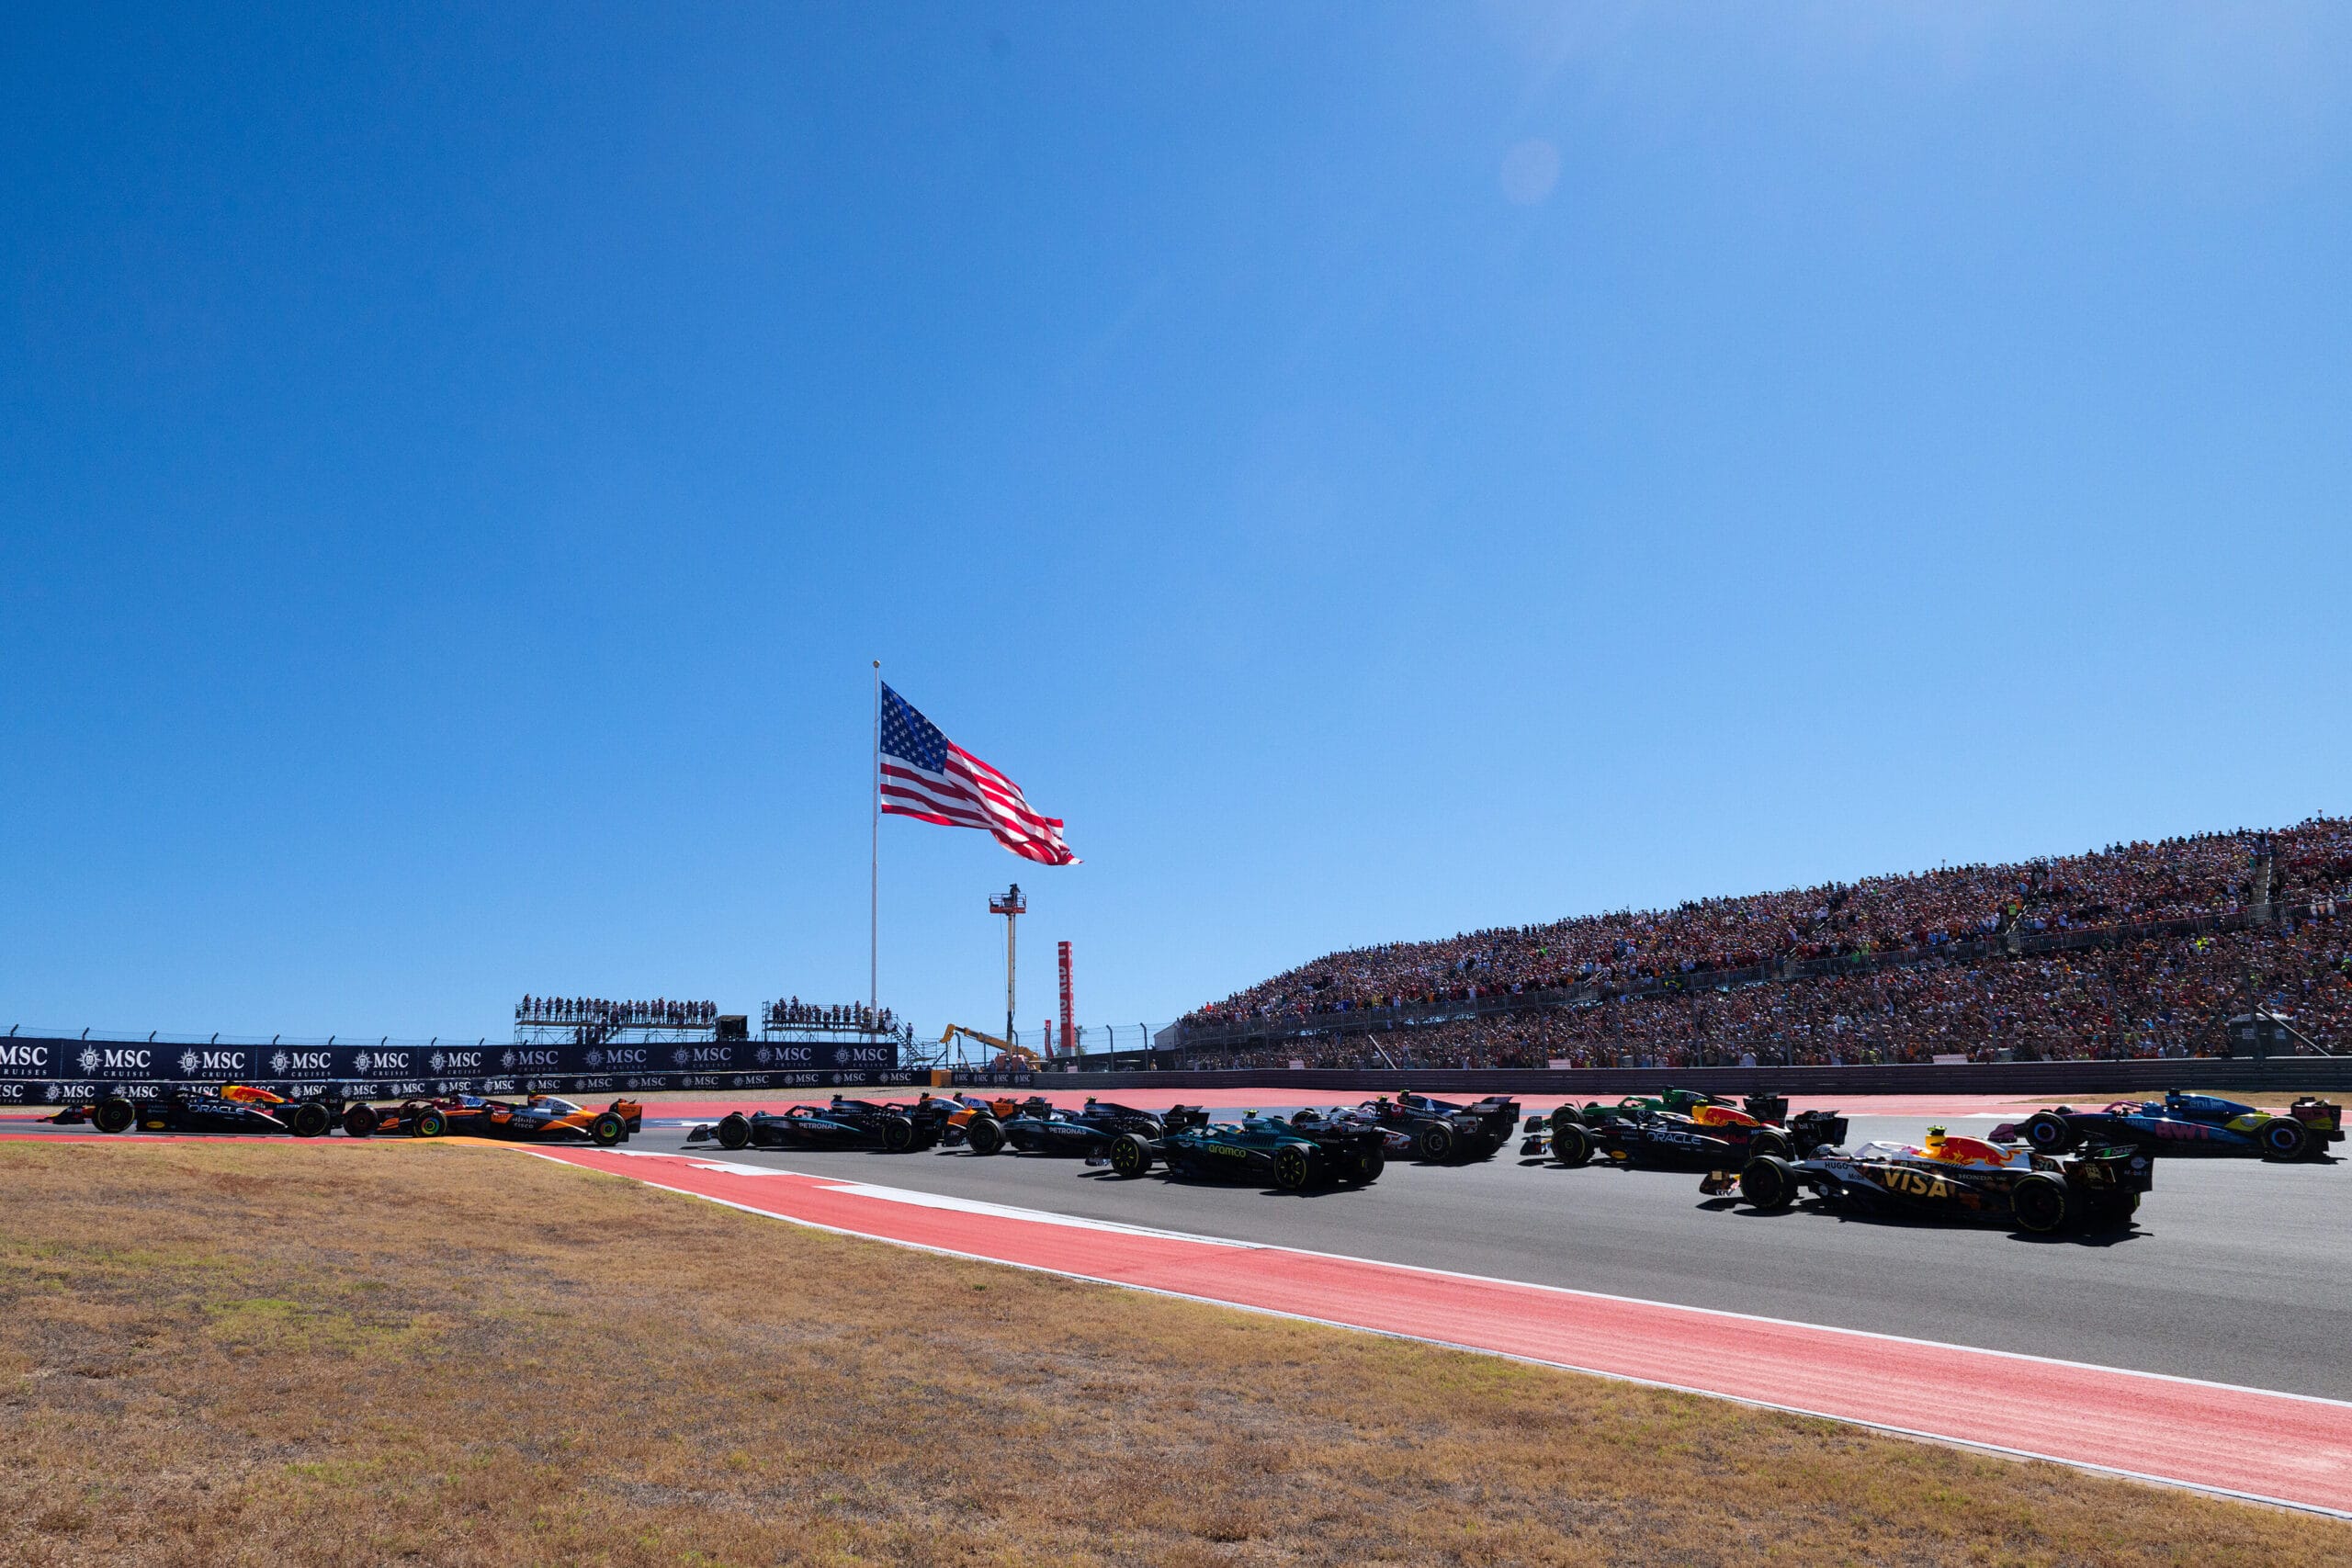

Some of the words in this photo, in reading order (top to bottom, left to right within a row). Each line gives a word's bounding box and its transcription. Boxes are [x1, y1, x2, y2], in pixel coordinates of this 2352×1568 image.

[0, 1045, 48, 1066] MSC
[104, 1049, 151, 1068] MSC
[447, 1052, 481, 1067] MSC
[518, 1050, 559, 1066] MSC
[606, 1049, 647, 1064] MSC
[693, 1047, 732, 1062] MSC
[775, 1047, 811, 1061] MSC
[853, 1048, 888, 1061] MSC
[202, 1052, 245, 1069] MSC
[291, 1052, 332, 1069] MSC
[373, 1053, 409, 1068] MSC
[640, 1077, 666, 1087] MSC
[695, 1077, 719, 1086] MSC
[745, 1076, 770, 1084] MSC
[796, 1074, 820, 1083] MSC
[843, 1073, 865, 1082] MSC
[890, 1073, 911, 1081] MSC
[958, 1073, 969, 1081] MSC
[978, 1074, 989, 1082] MSC
[998, 1073, 1009, 1082] MSC
[1019, 1074, 1031, 1083] MSC
[402, 1083, 425, 1093] MSC
[449, 1081, 471, 1091] MSC
[493, 1080, 514, 1089] MSC
[537, 1079, 560, 1089] MSC
[587, 1078, 613, 1088] MSC
[0, 1084, 24, 1098] SC
[62, 1085, 95, 1098] MSC
[128, 1086, 159, 1098] MSC
[302, 1085, 327, 1096] MSC
[353, 1085, 378, 1095] MSC
[188, 1103, 245, 1115] ORACLE
[1048, 1126, 1087, 1135] PETRONAS
[2154, 1122, 2210, 1140] BWT
[1646, 1131, 1702, 1145] ORACLE
[1208, 1144, 1247, 1158] aramco
[1825, 1161, 1849, 1169] HUGO
[1884, 1168, 1948, 1198] VISA
